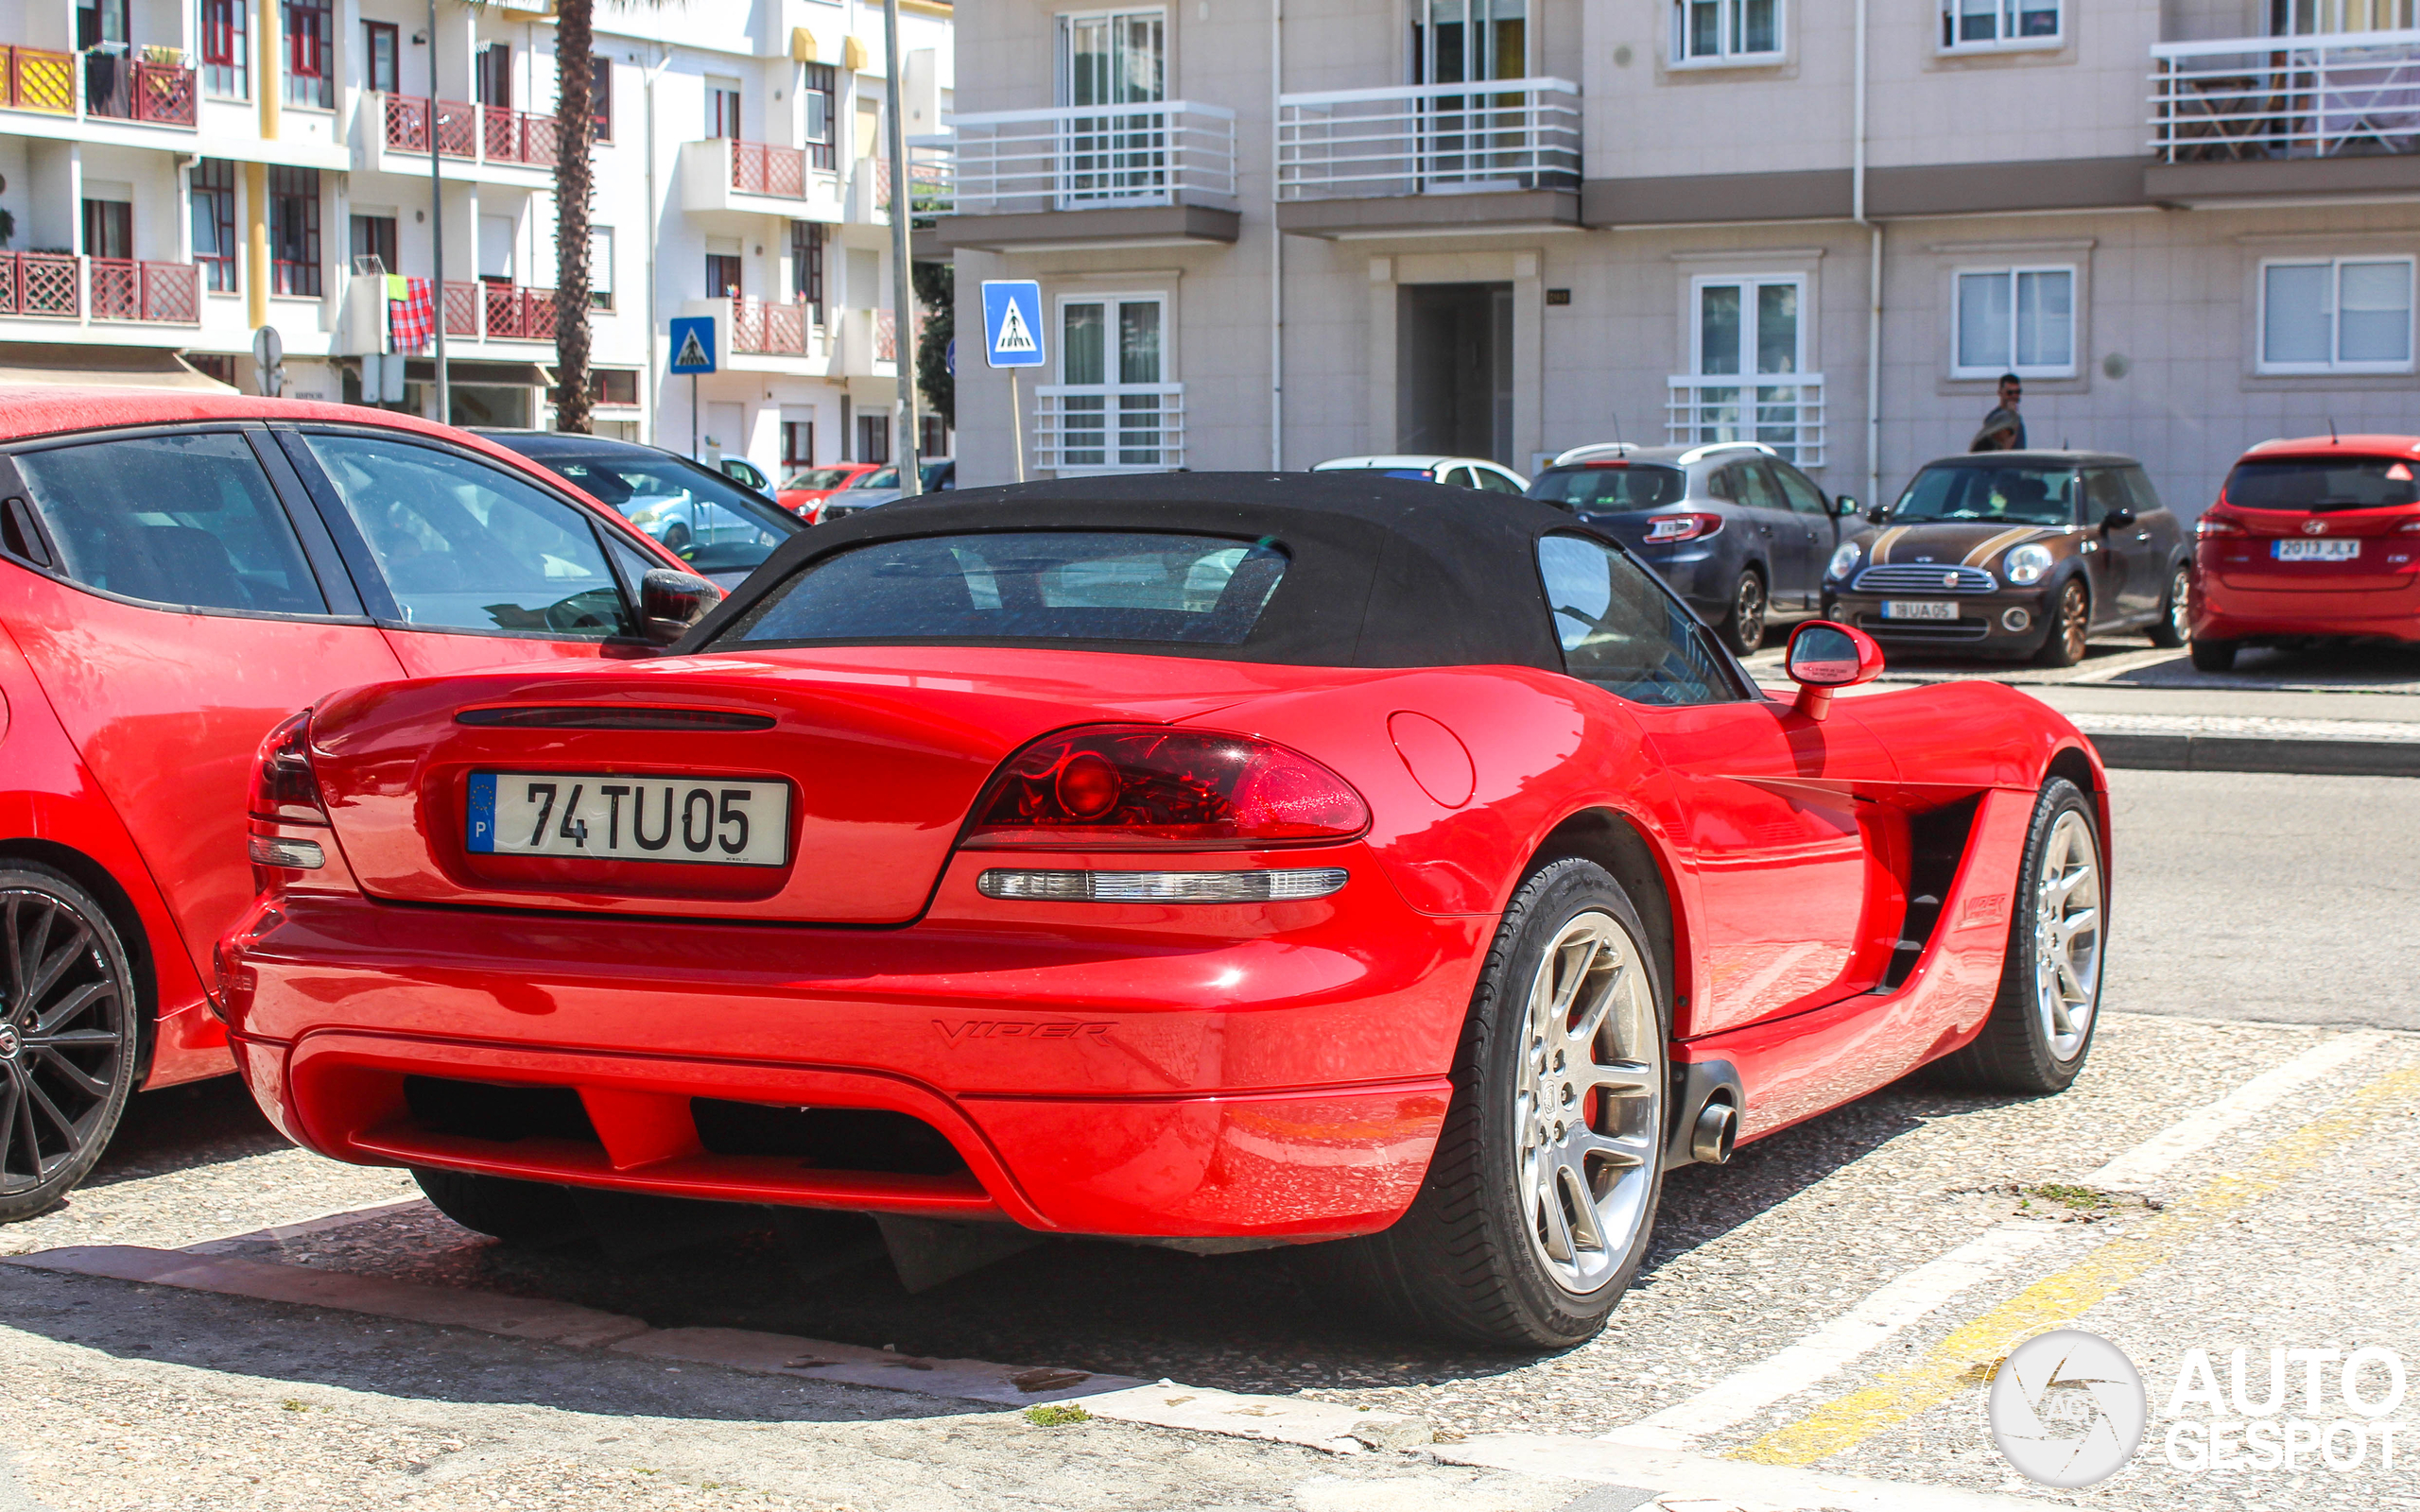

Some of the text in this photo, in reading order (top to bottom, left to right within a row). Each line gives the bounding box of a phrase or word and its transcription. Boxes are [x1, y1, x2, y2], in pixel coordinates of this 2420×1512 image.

[2283, 541, 2321, 555] 2013
[475, 821, 487, 838] P
[931, 1019, 1119, 1050] VIPER
